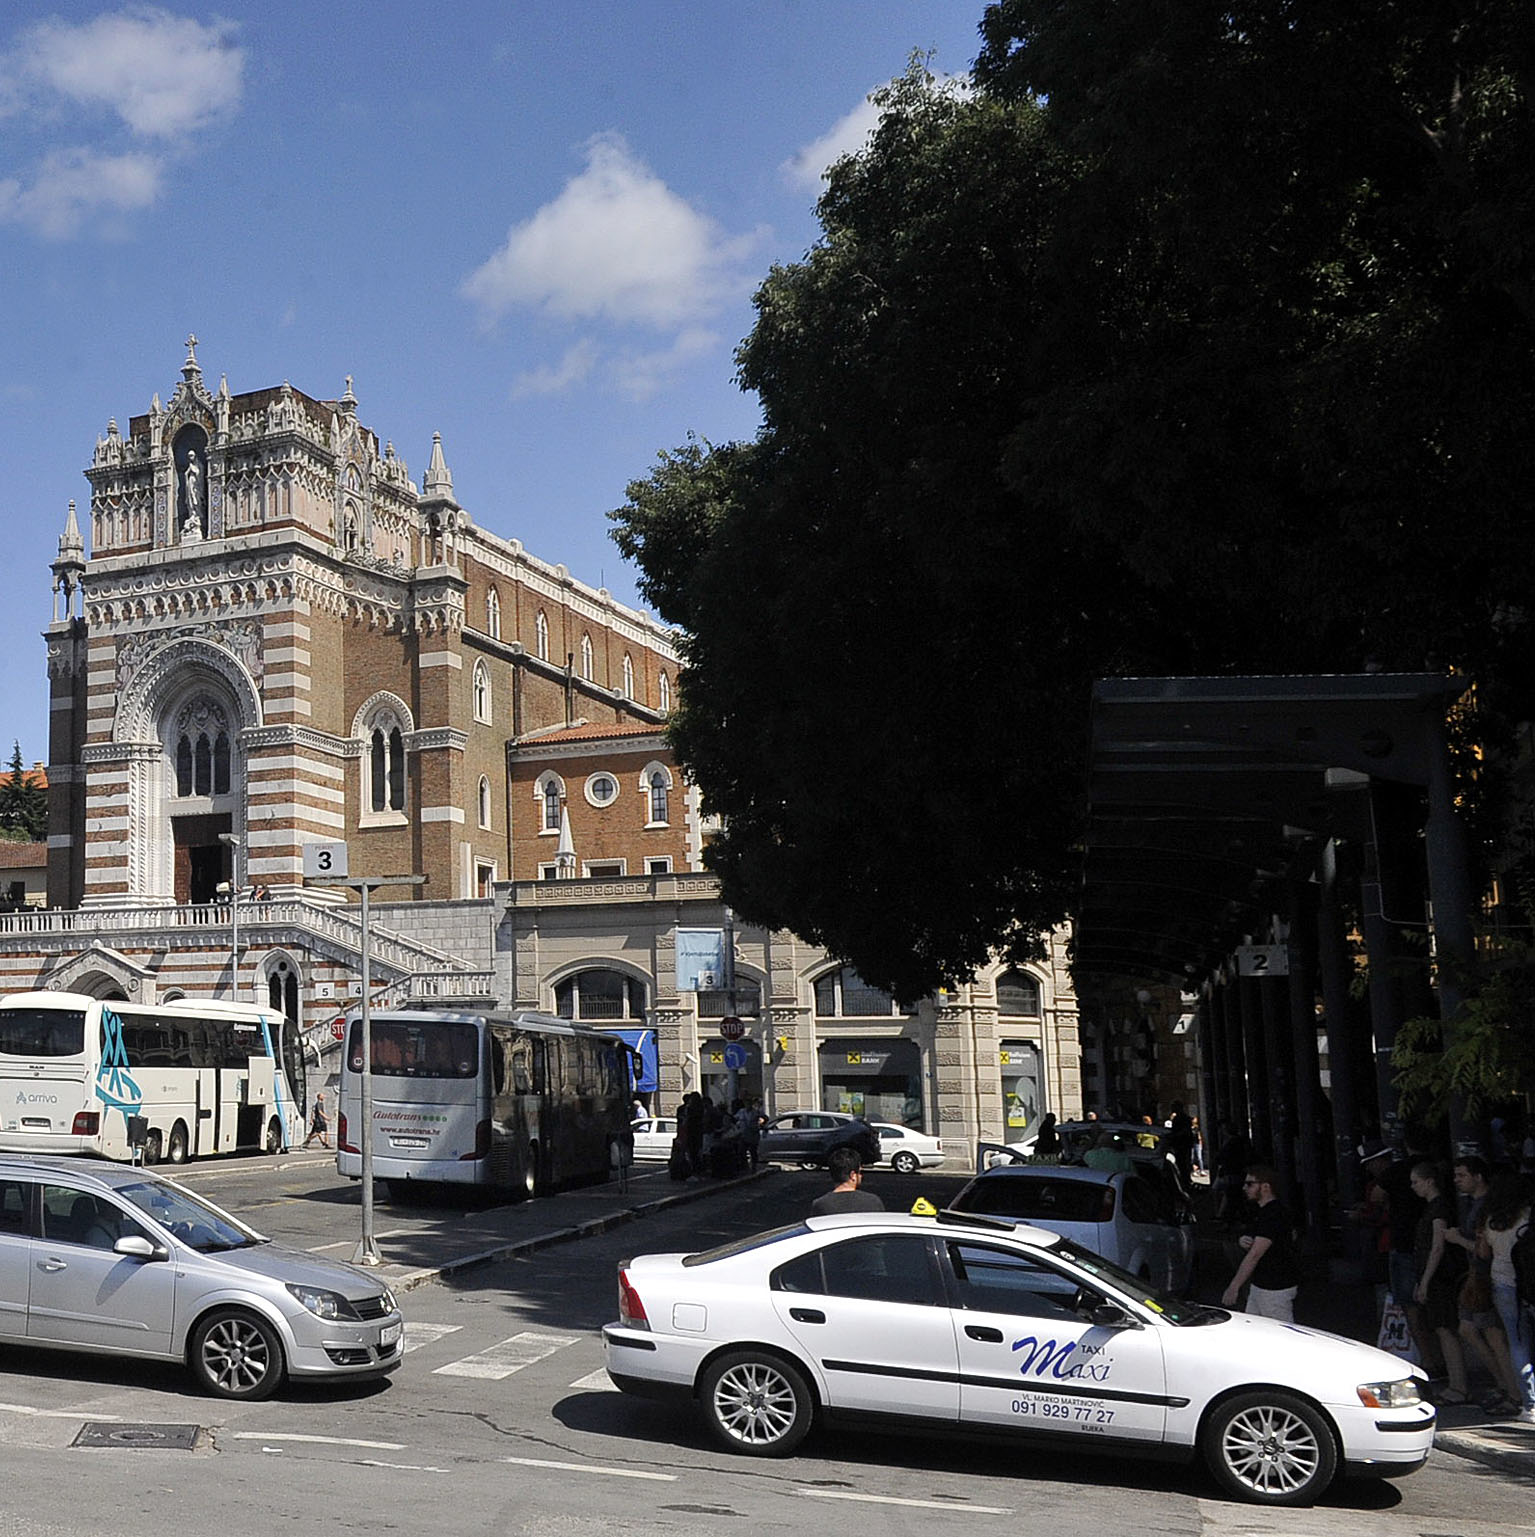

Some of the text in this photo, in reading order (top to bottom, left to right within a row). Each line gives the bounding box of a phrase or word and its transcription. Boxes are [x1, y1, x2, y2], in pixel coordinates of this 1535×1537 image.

[318, 851, 332, 870] 3
[1254, 955, 1268, 970] 2
[706, 976, 713, 984] 3
[322, 988, 329, 997] 5
[355, 986, 362, 995] 4
[721, 1024, 743, 1034] STOP
[1178, 1020, 1185, 1030] 1
[1081, 1344, 1106, 1356] TAXI
[1012, 1336, 1114, 1382] Maxi
[1034, 1395, 1060, 1404] MARKO
[1012, 1400, 1115, 1424] 091 929 77 27
[1081, 1424, 1105, 1433] RIJEKA
